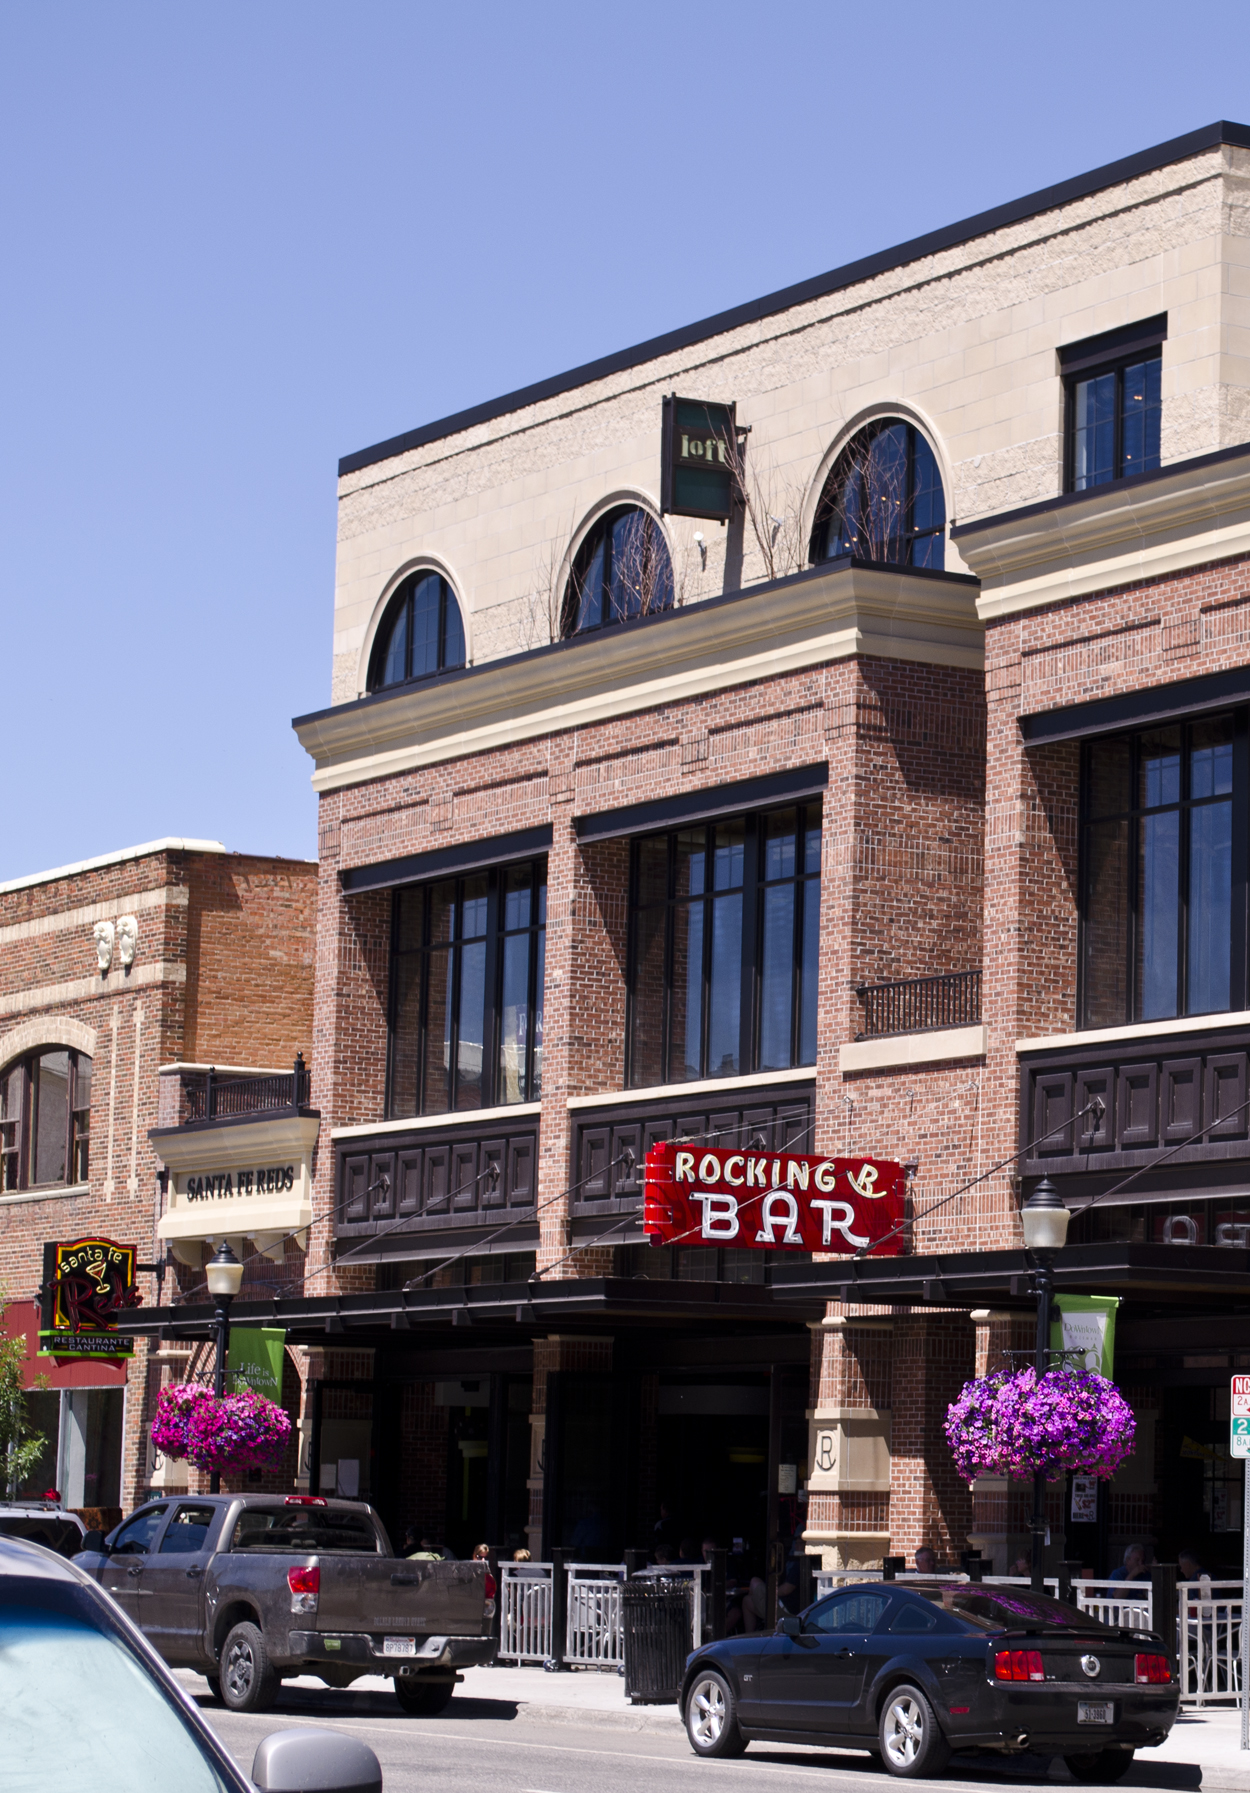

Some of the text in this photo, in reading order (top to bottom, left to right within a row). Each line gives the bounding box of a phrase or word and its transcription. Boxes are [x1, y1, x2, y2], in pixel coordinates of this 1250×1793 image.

[681, 434, 727, 463] loft
[187, 1166, 294, 1202] SANTA FE REDS
[675, 1151, 888, 1199] ROCKING R
[688, 1190, 870, 1248] BAR
[60, 1246, 122, 1273] santa fe
[47, 1274, 144, 1334] Reds
[54, 1337, 130, 1346] RESTAURANTE
[68, 1343, 116, 1352] CANTINA
[1237, 1419, 1248, 1435] 2
[816, 1435, 836, 1472] R
